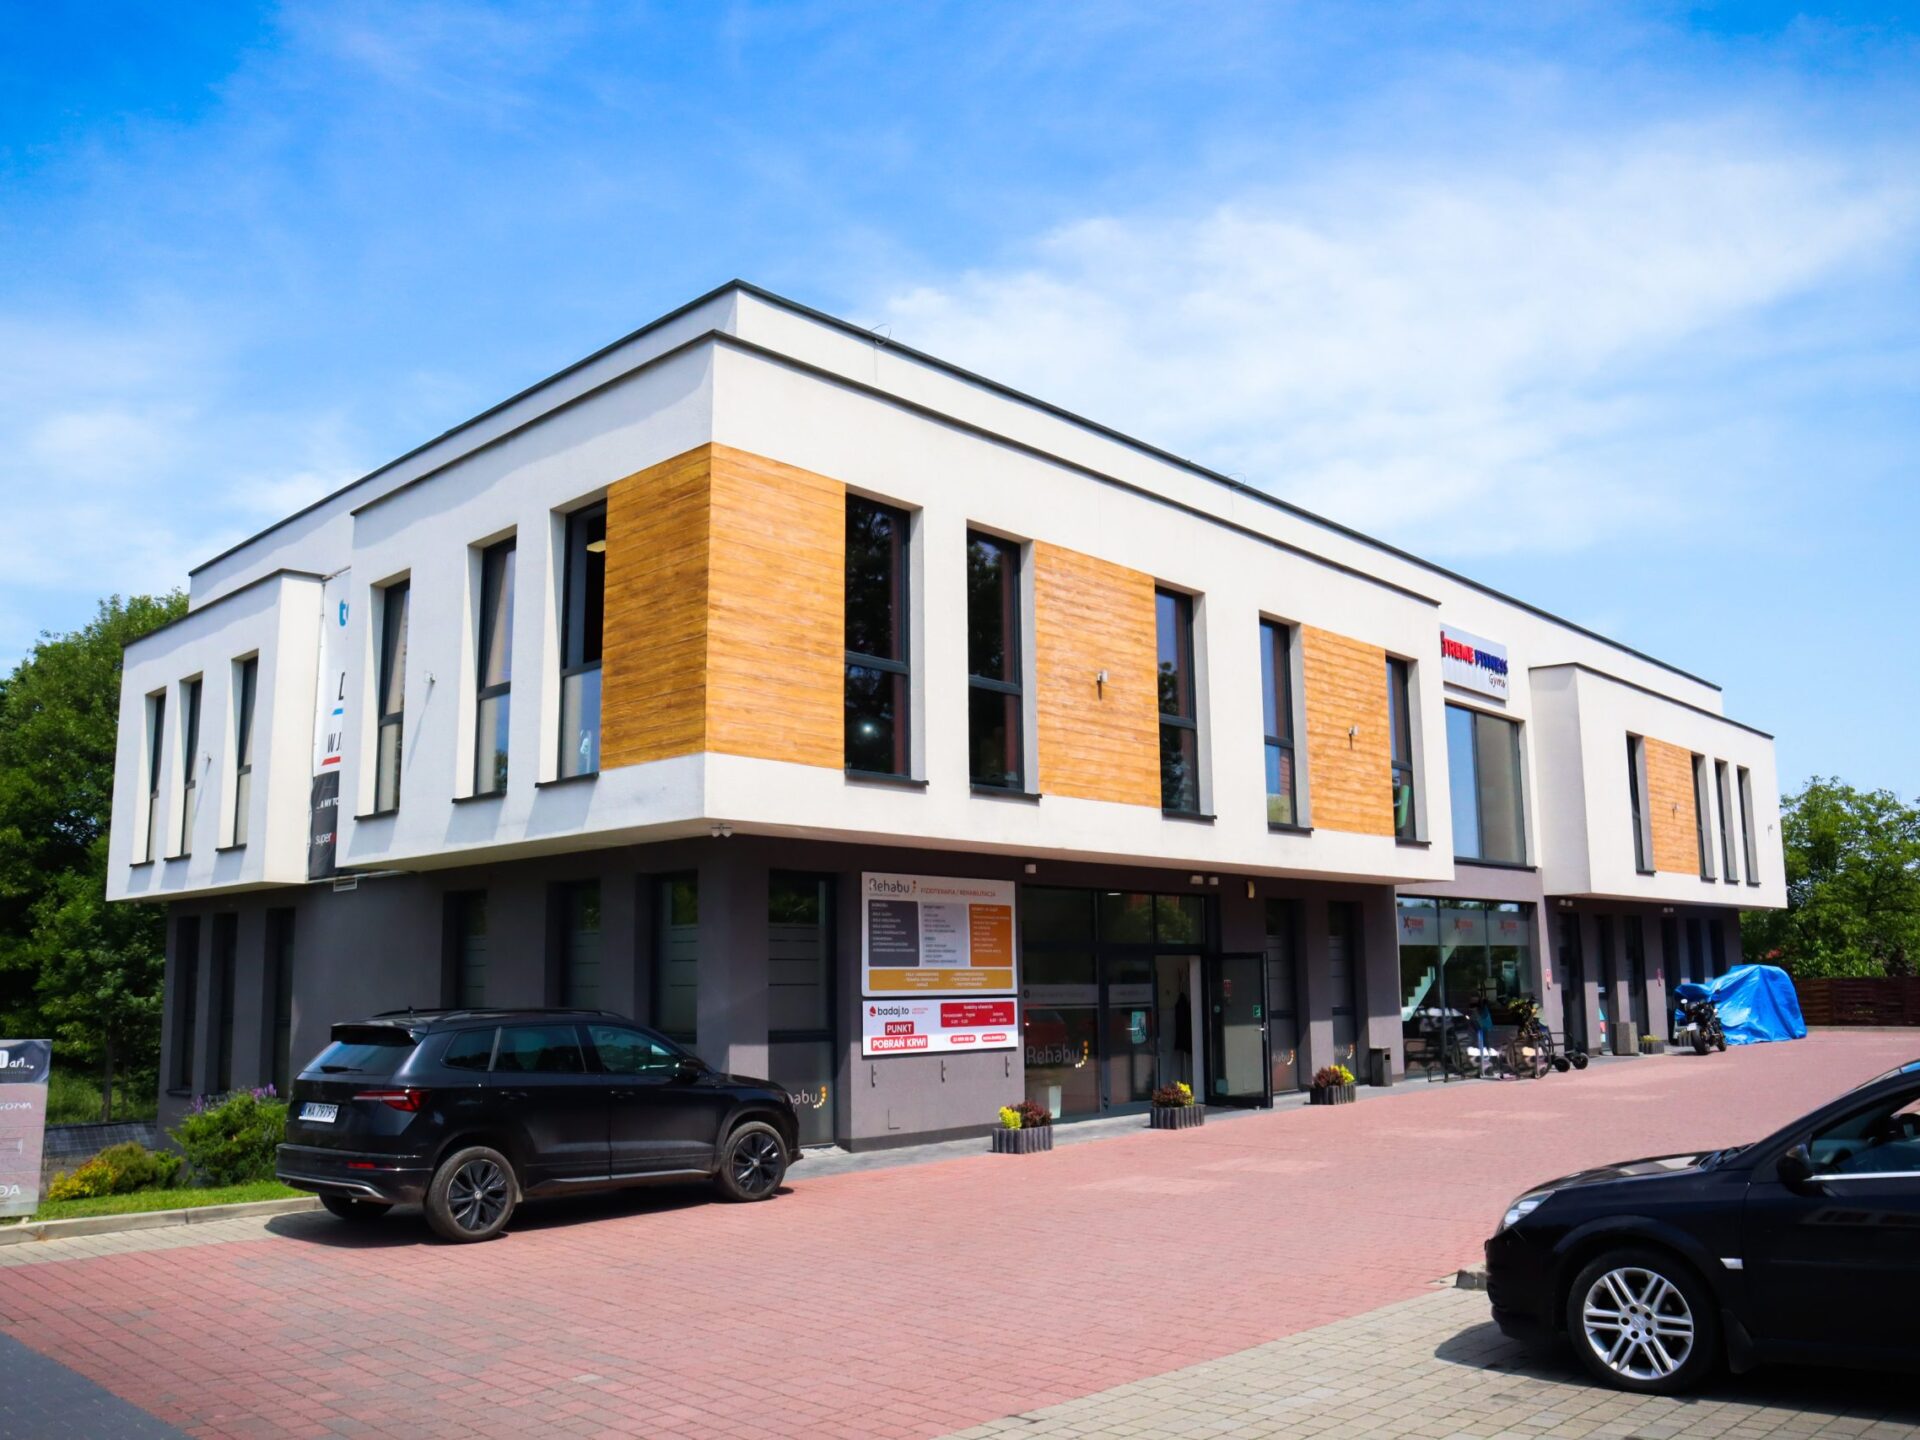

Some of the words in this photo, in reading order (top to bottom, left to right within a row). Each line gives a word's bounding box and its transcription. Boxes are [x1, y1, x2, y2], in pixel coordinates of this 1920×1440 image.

[1474, 649, 1509, 676] FITNESS
[878, 1006, 910, 1017] badaj.to
[886, 1023, 912, 1034] PUNKT
[872, 1037, 905, 1049] POBRAŃ
[906, 1037, 927, 1047] KRWI
